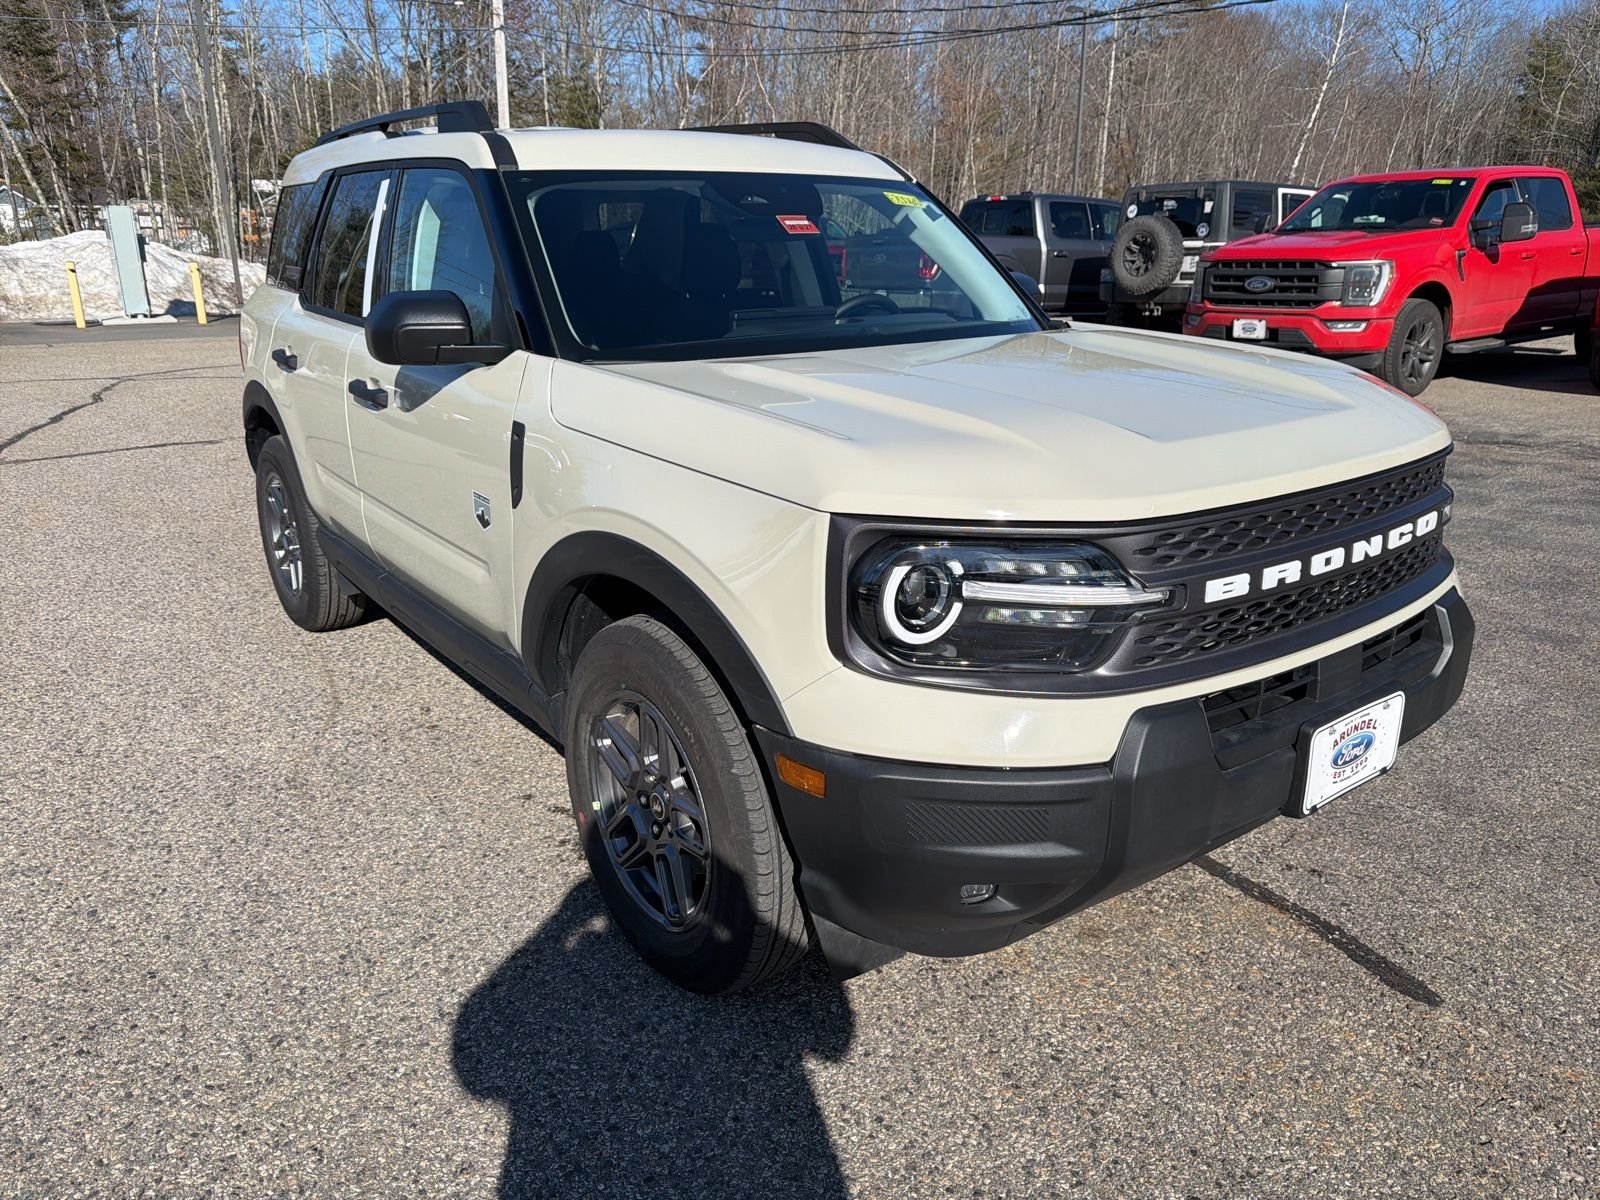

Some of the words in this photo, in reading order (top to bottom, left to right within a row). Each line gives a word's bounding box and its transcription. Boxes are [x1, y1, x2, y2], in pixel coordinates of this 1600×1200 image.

[1204, 510, 1439, 604] BRONCO
[1332, 718, 1378, 751] ARUNDEL
[1337, 736, 1368, 766] Ford
[1333, 769, 1347, 780] EST
